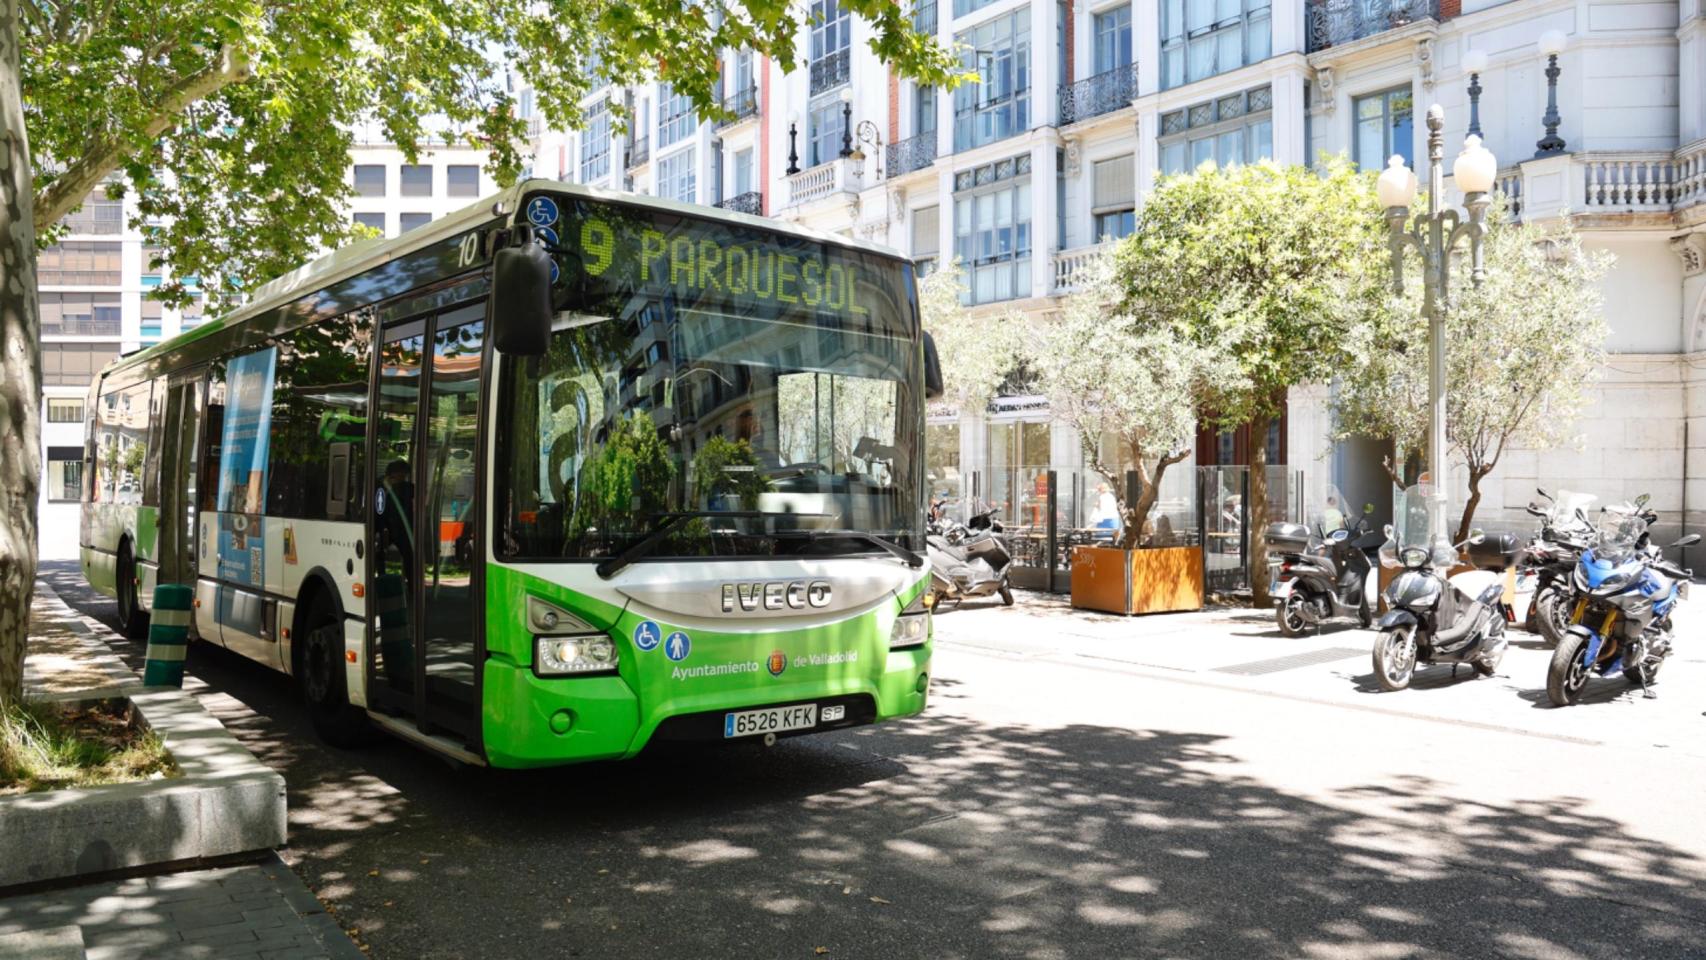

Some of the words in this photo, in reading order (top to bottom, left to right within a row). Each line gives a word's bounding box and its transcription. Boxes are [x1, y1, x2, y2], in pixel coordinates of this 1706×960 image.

[458, 232, 478, 268] 10
[579, 219, 614, 276] 9
[641, 229, 868, 314] PARQUESOL
[721, 580, 833, 612] IVECO
[671, 660, 760, 681] Ayuntamiento
[793, 655, 807, 668] de
[809, 650, 858, 665] Valladolid
[736, 711, 778, 733] 6526
[783, 706, 813, 728] KFK
[823, 706, 843, 720] SP
